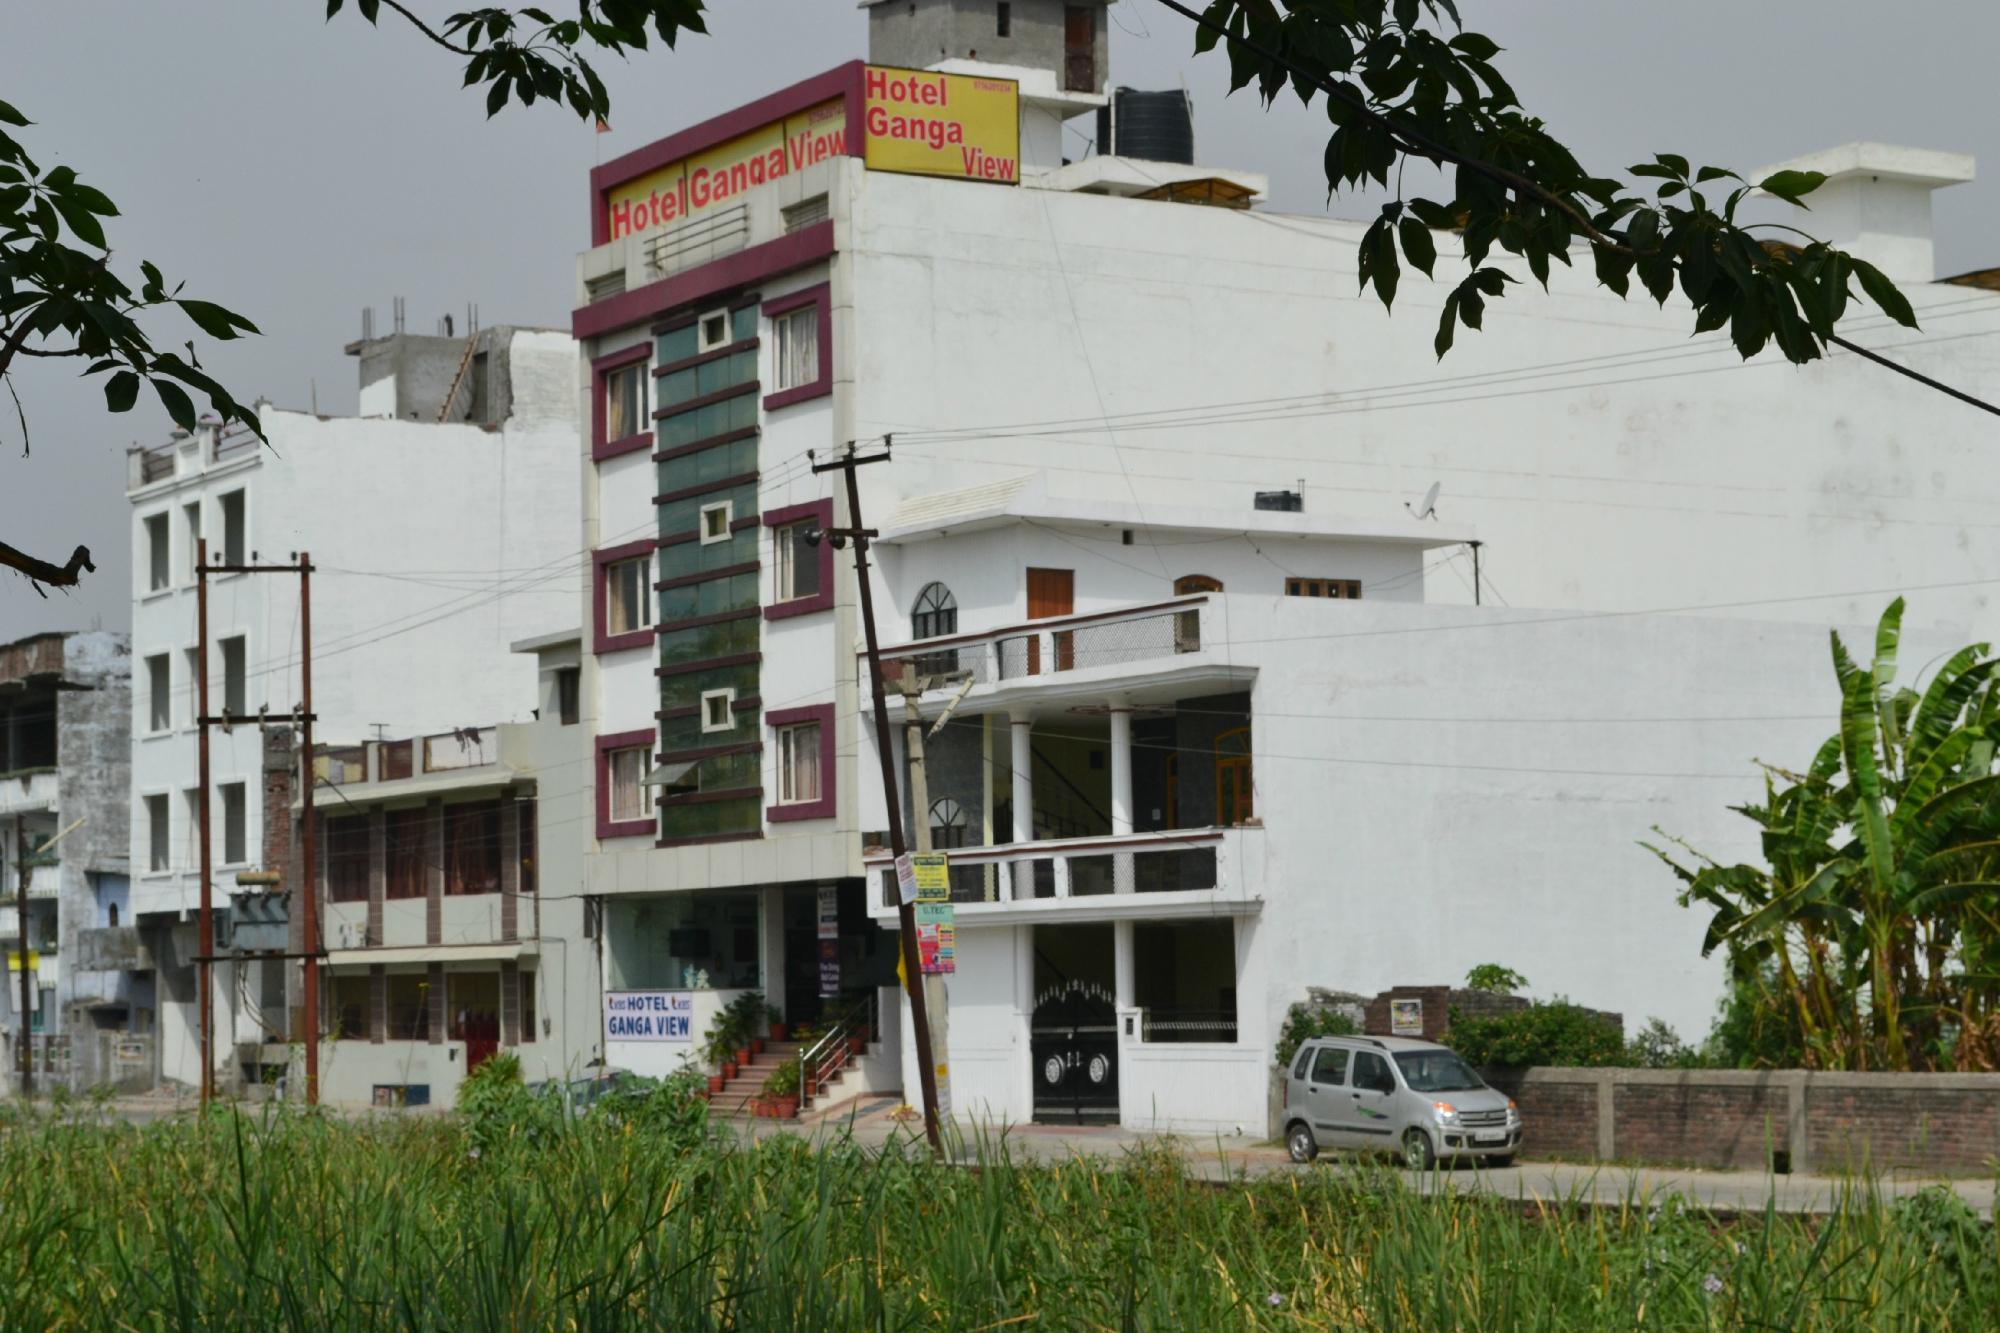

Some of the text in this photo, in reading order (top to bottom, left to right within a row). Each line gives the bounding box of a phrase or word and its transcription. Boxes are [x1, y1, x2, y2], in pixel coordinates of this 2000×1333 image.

[866, 70, 947, 107] Hotel
[866, 106, 963, 150] Ganga
[961, 146, 1015, 181] View
[611, 127, 847, 241] Hotel Ganga View
[627, 996, 669, 1011] HOTEL
[608, 1016, 689, 1035] GANGA VIEW
